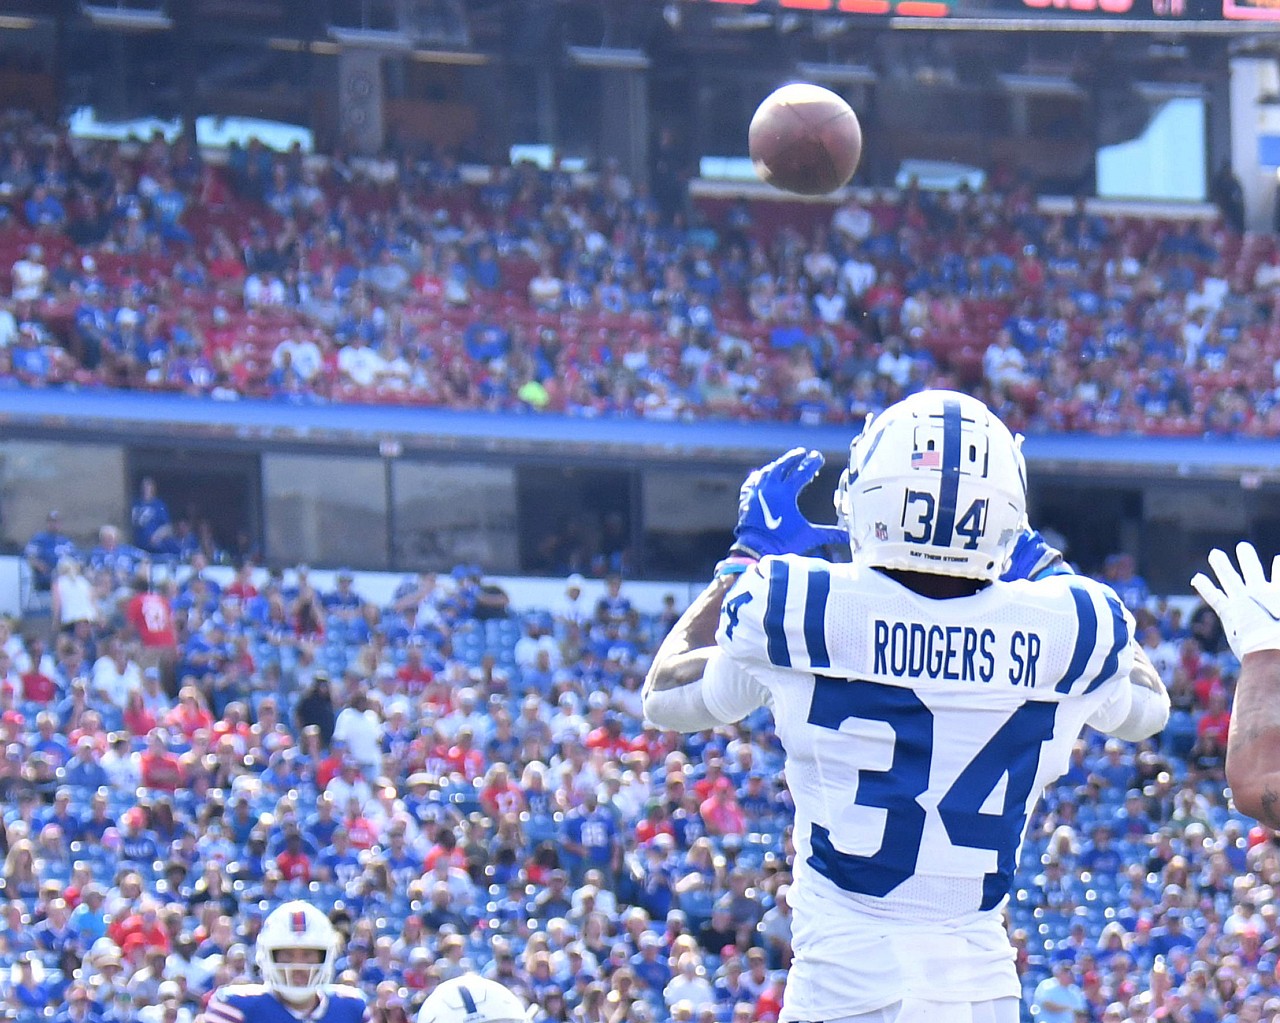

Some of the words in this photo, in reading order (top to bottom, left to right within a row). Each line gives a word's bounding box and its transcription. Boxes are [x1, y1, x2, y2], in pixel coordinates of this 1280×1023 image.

[903, 488, 986, 550] 34
[873, 619, 996, 683] RODGERS
[1008, 630, 1041, 689] SR
[806, 673, 1059, 912] 34
